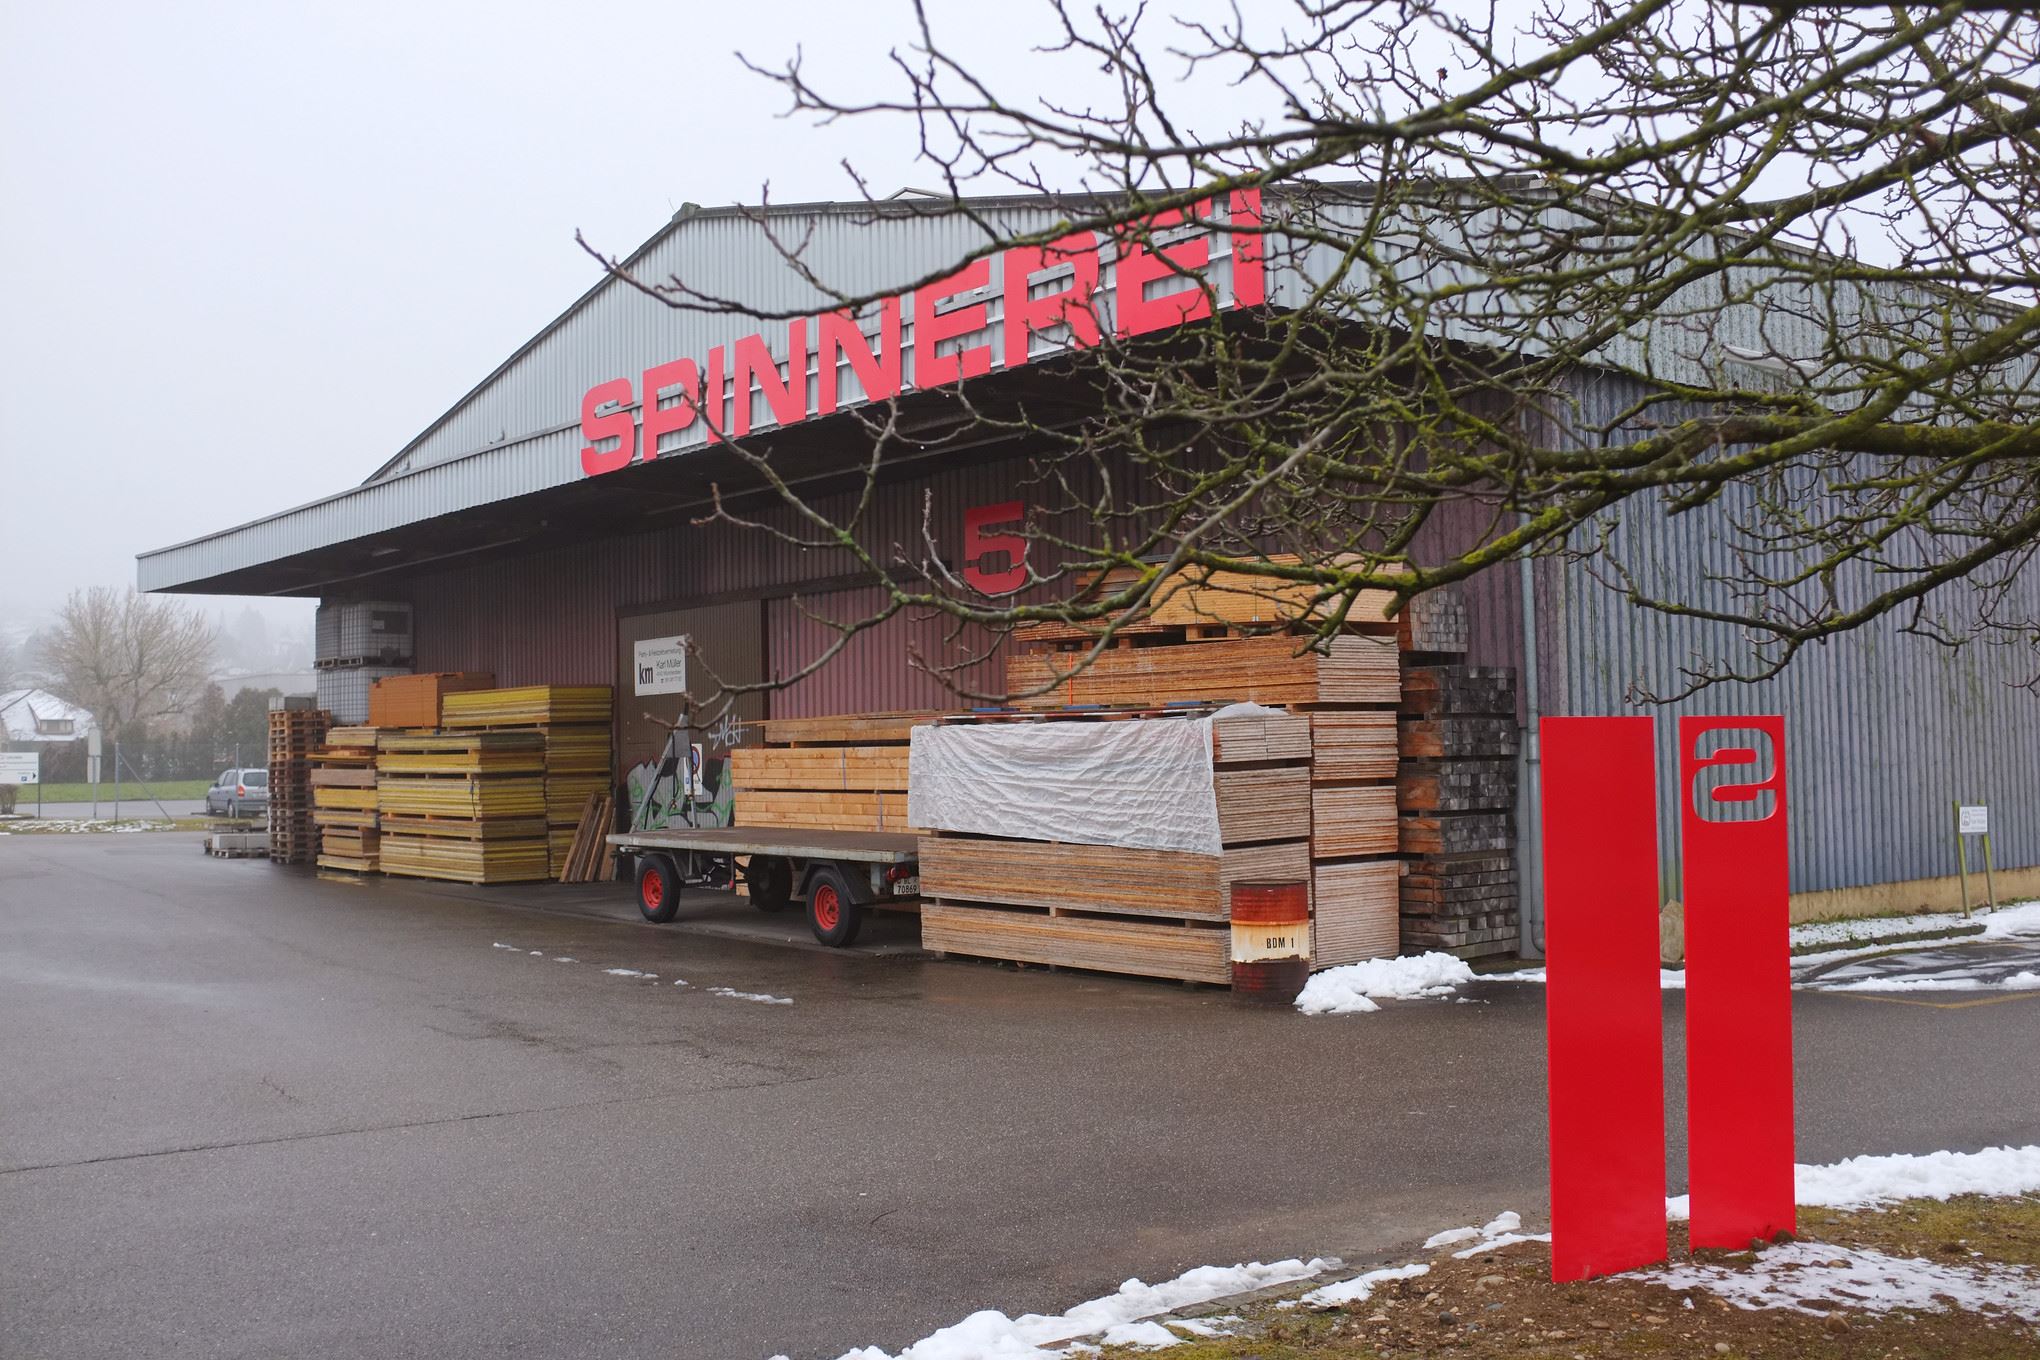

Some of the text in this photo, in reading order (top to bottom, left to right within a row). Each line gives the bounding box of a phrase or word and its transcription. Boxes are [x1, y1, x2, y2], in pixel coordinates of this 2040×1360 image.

[581, 170, 1264, 476] SPINNEREI
[962, 501, 1027, 595] 5
[639, 663, 654, 684] km
[1692, 727, 1778, 823] 2
[897, 885, 917, 893] 70869
[1266, 937, 1285, 949] BDM
